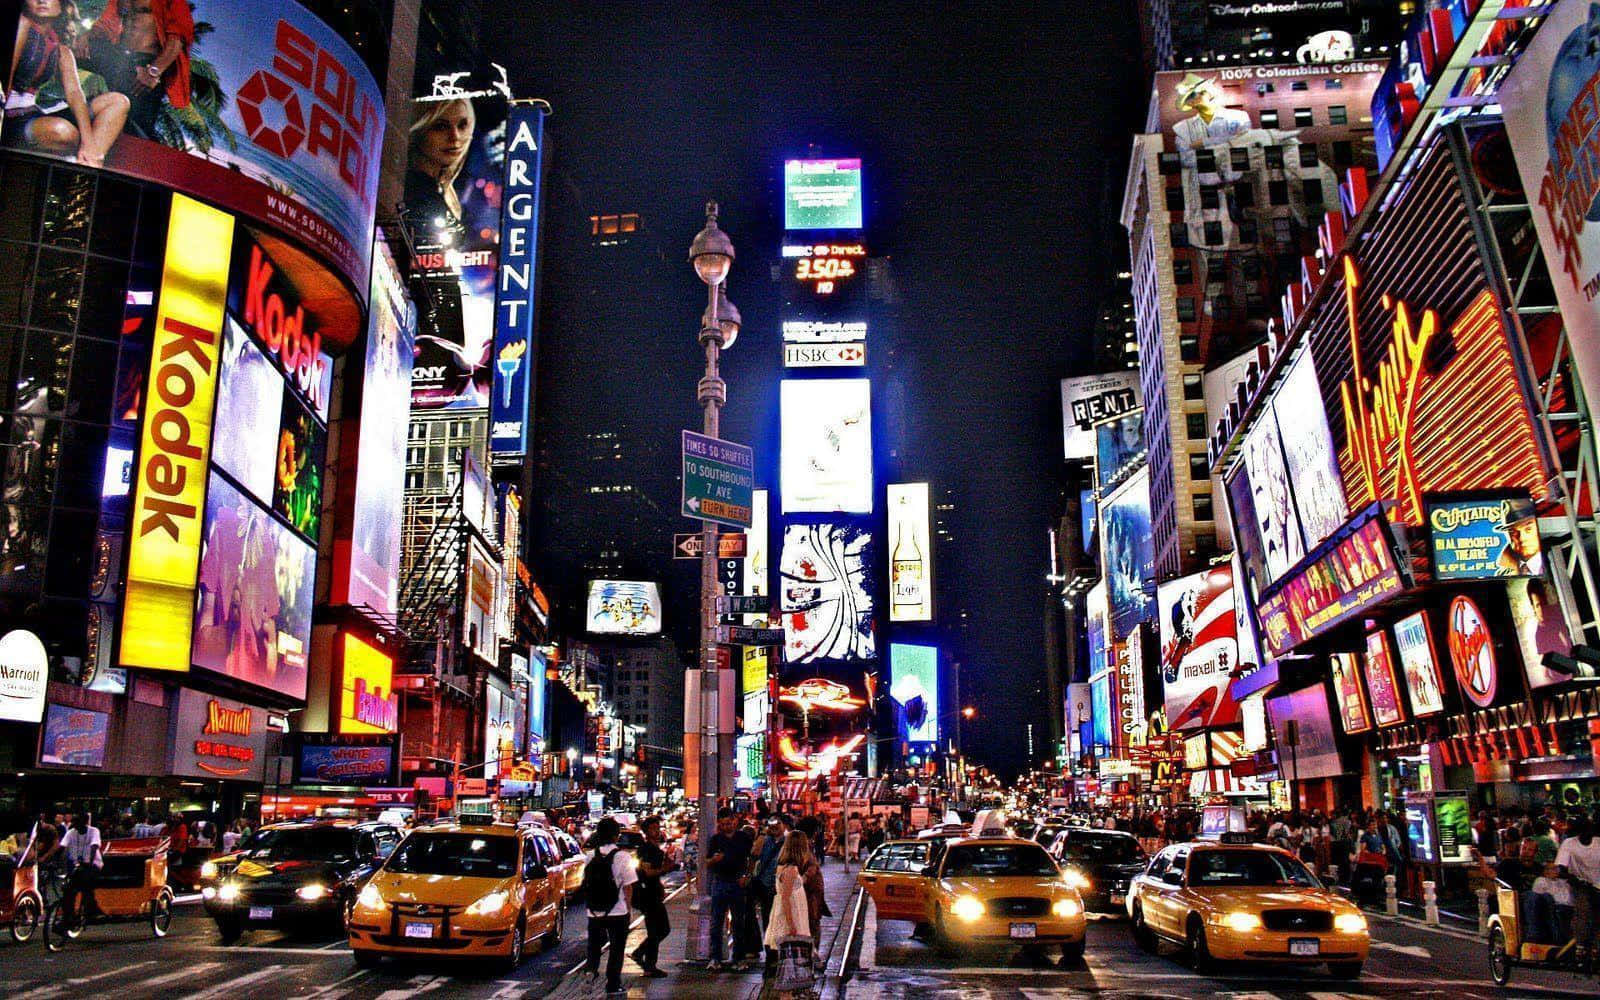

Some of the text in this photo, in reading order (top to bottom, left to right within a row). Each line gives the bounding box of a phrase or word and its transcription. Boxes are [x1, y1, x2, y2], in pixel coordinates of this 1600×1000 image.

[1221, 62, 1378, 80] 100% Colombian Coffee
[500, 120, 539, 328] ARGENT
[245, 245, 328, 412] Kodak
[787, 348, 833, 362] HSBC
[140, 317, 216, 543] Kodak
[686, 439, 706, 454] TIMES
[686, 461, 751, 487] TO SOUTHBOUND
[716, 485, 732, 499] AVE
[703, 500, 749, 520] TURN HERE
[744, 596, 757, 608] 45
[1183, 659, 1216, 678] maxell
